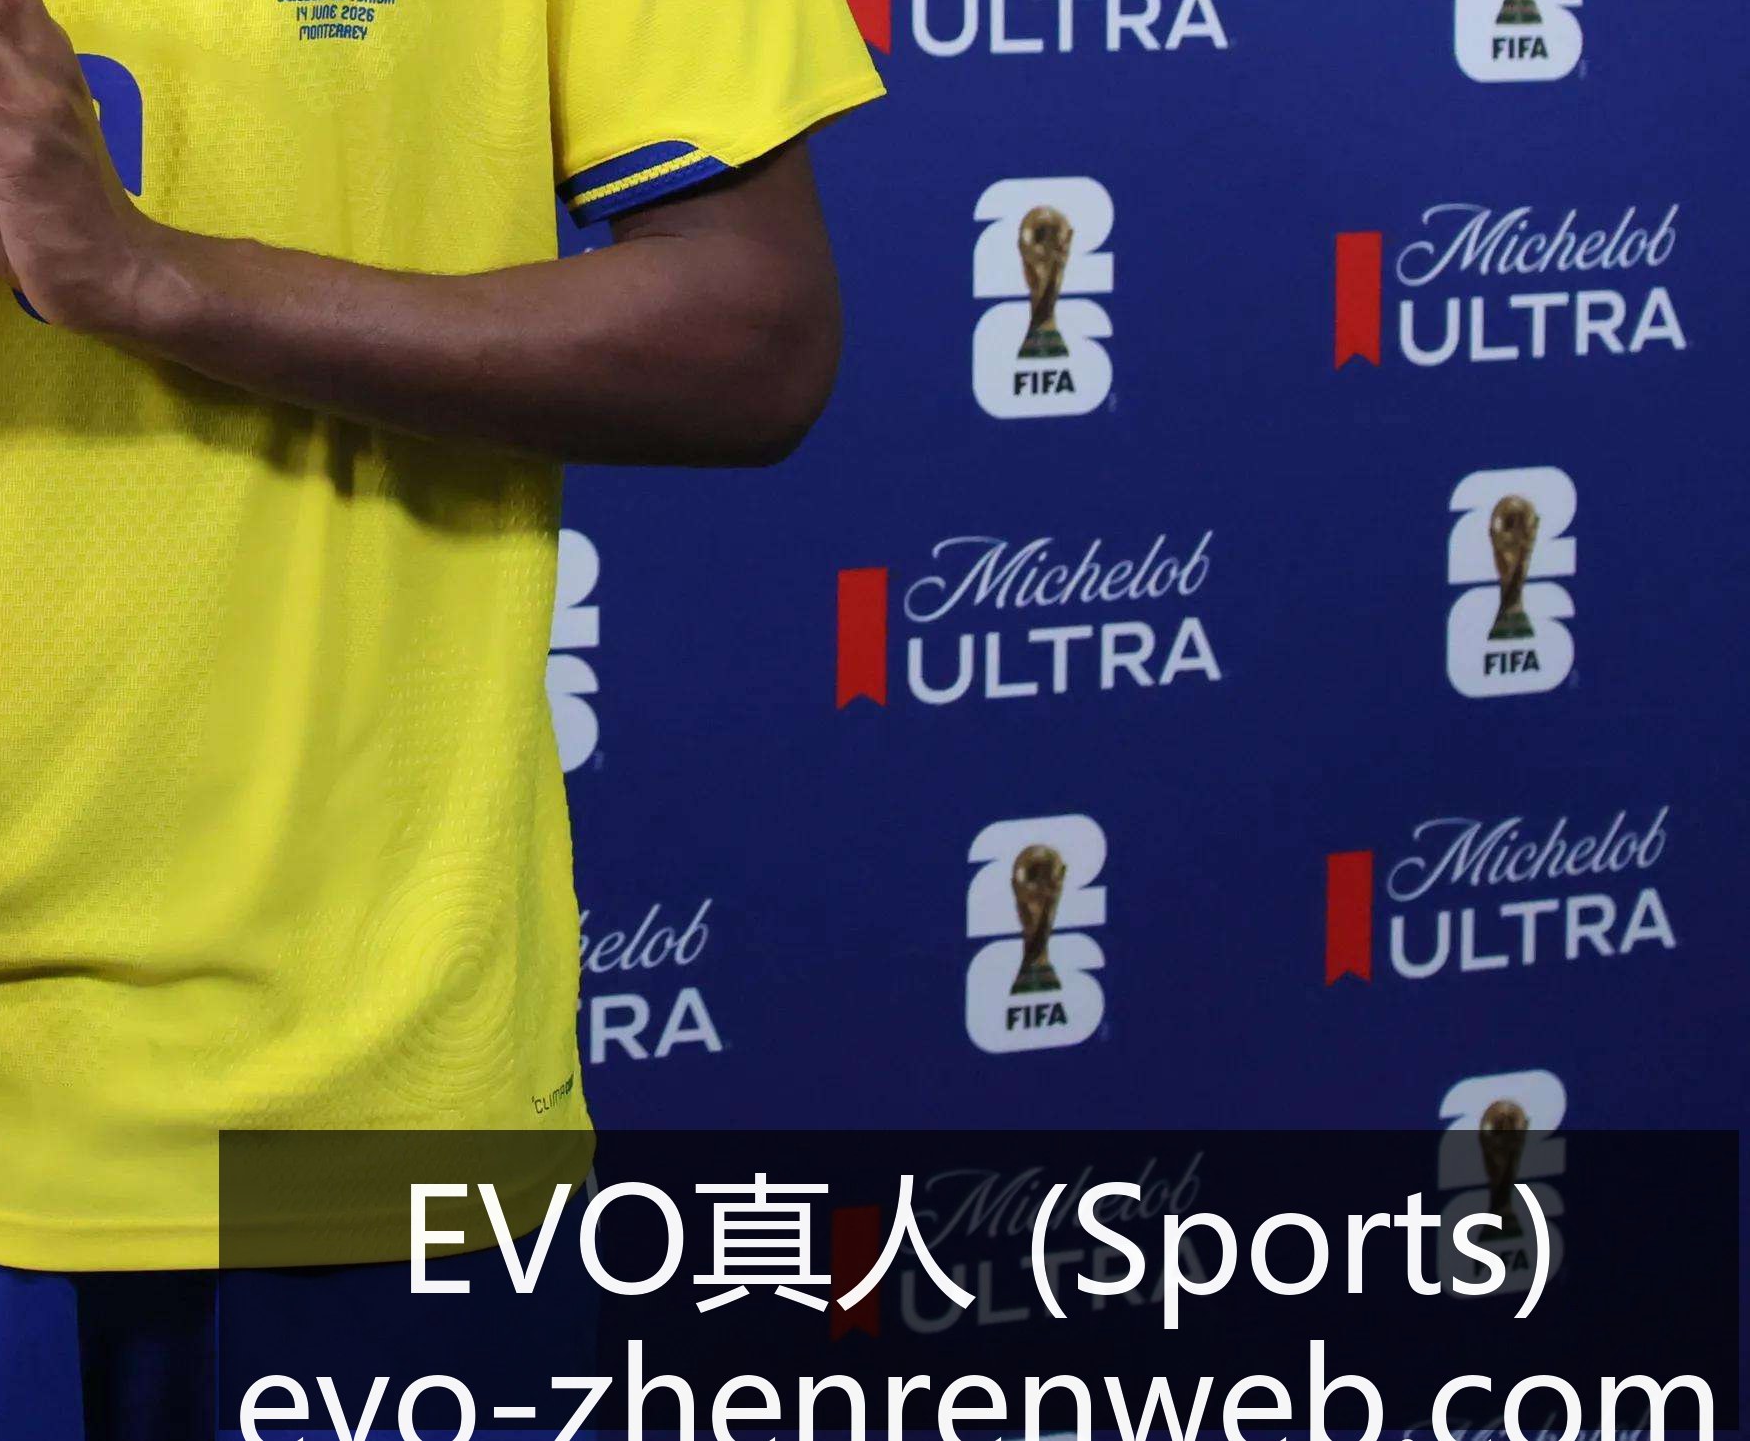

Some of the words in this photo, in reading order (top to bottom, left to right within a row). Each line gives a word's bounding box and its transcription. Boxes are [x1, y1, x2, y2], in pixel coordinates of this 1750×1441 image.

[296, 5, 308, 21] 14
[310, 4, 338, 21] JUNE
[340, 5, 375, 23] 2026
[299, 23, 368, 41] MONTERREY
[1492, 36, 1549, 60] FIFA
[1396, 203, 1679, 287] Michelob
[1399, 286, 1687, 367] ULTRA
[1013, 369, 1075, 396] FIFA
[903, 530, 1213, 623] Michelob
[907, 616, 1223, 706] ULTRA
[1483, 649, 1540, 676] FIFA
[1387, 805, 1669, 902] Michelob
[1390, 887, 1677, 980] ULTRA
[1005, 1002, 1068, 1031] FIFA
